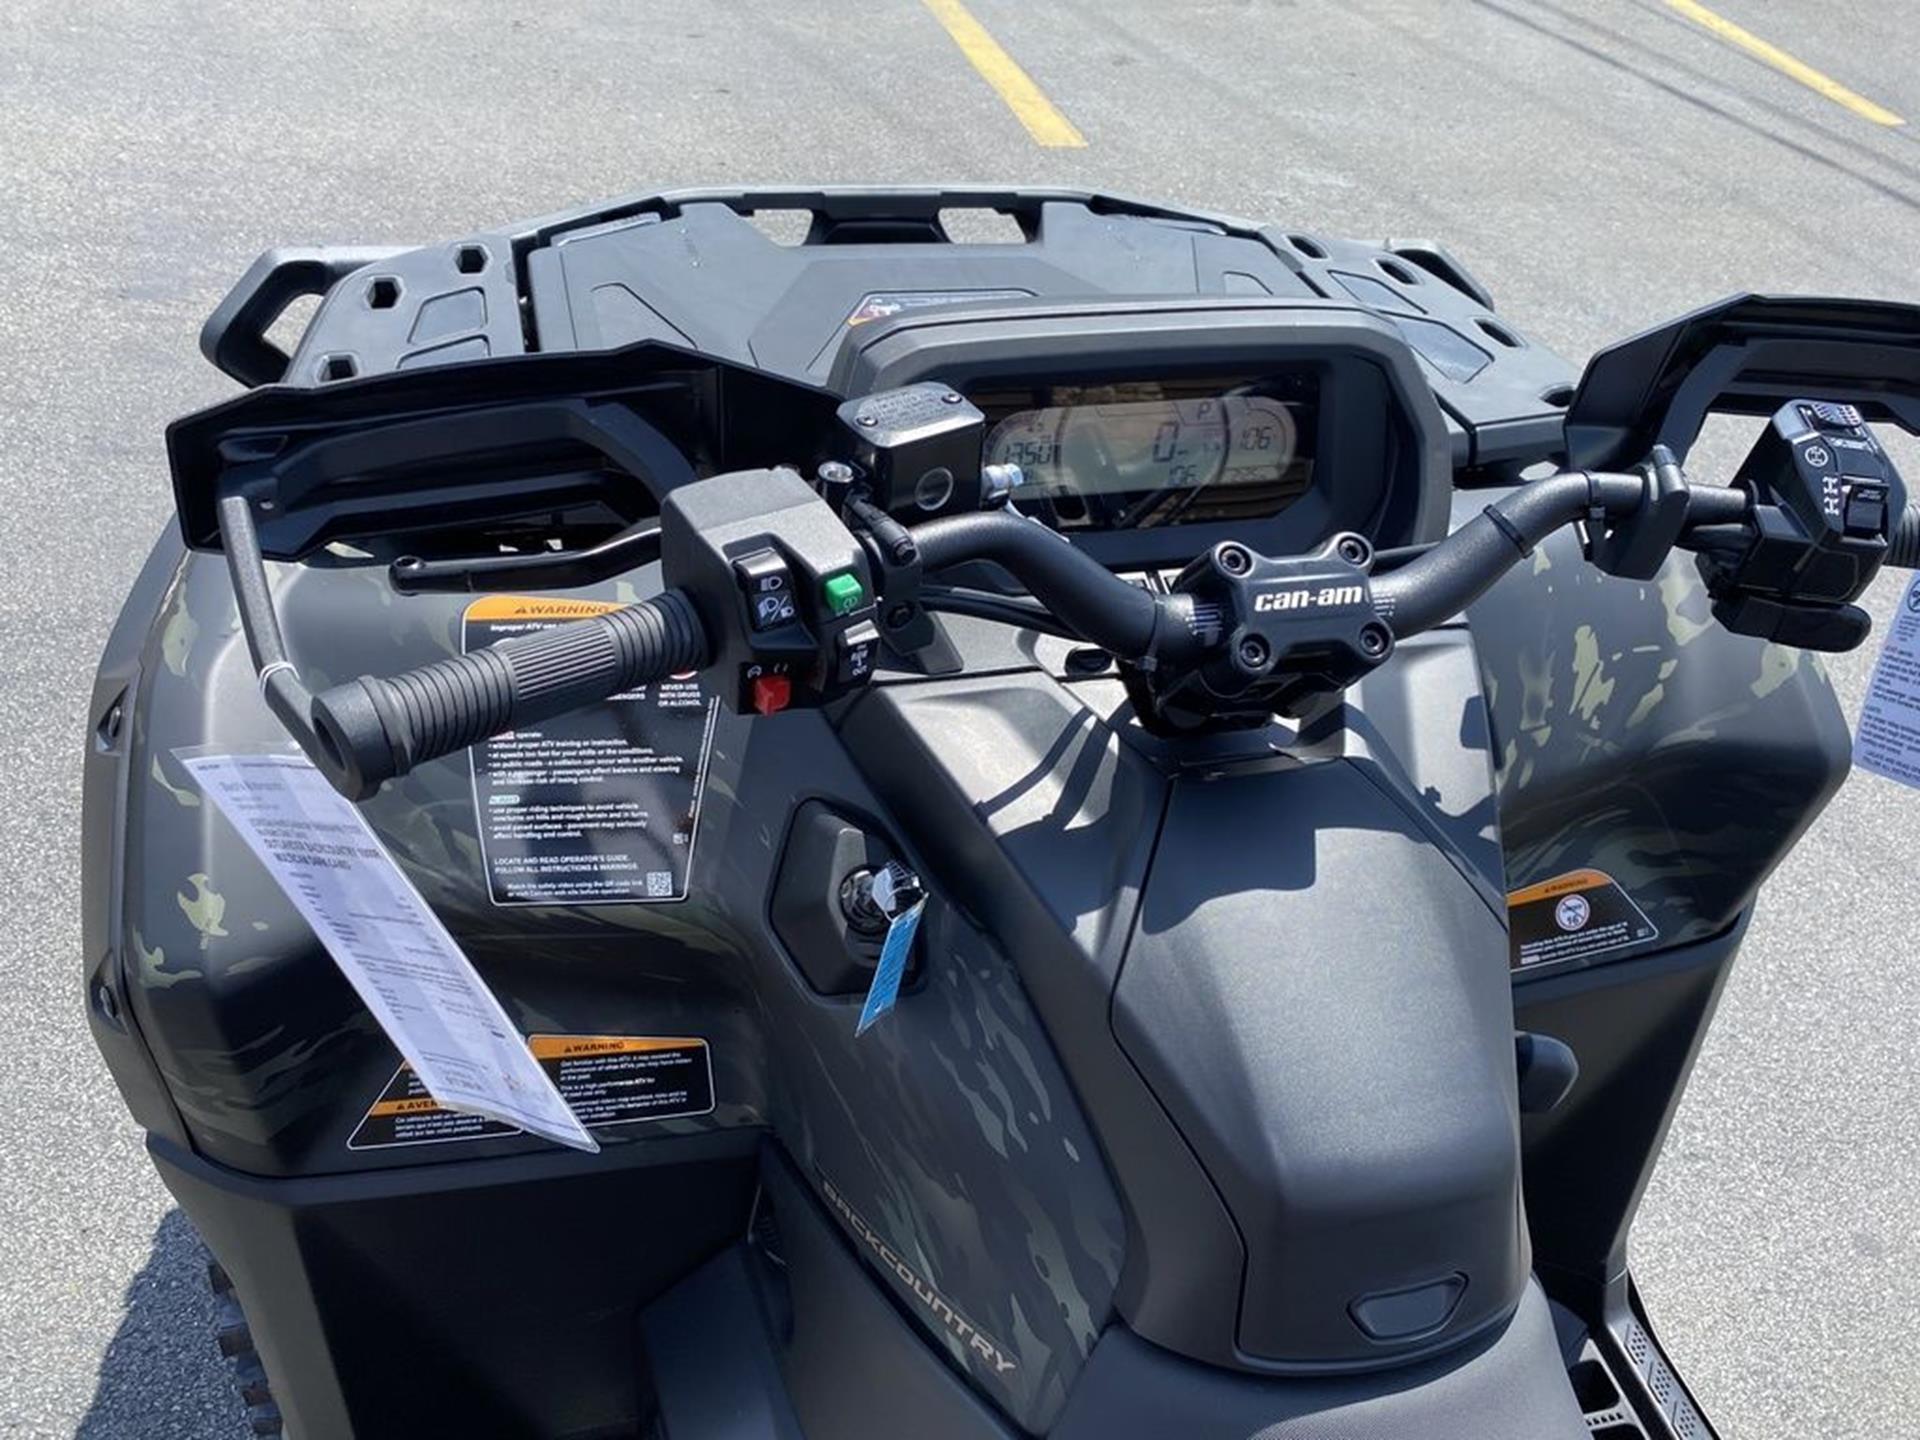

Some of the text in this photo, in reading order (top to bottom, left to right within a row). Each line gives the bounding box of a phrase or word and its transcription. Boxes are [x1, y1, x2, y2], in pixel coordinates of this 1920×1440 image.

[1254, 586, 1363, 612] can-am
[529, 605, 609, 615] WARNING
[525, 622, 543, 630] ATV
[523, 856, 539, 865] AND
[573, 1040, 625, 1052] WARNING
[824, 1180, 1016, 1372] BACKCOUNTRY
